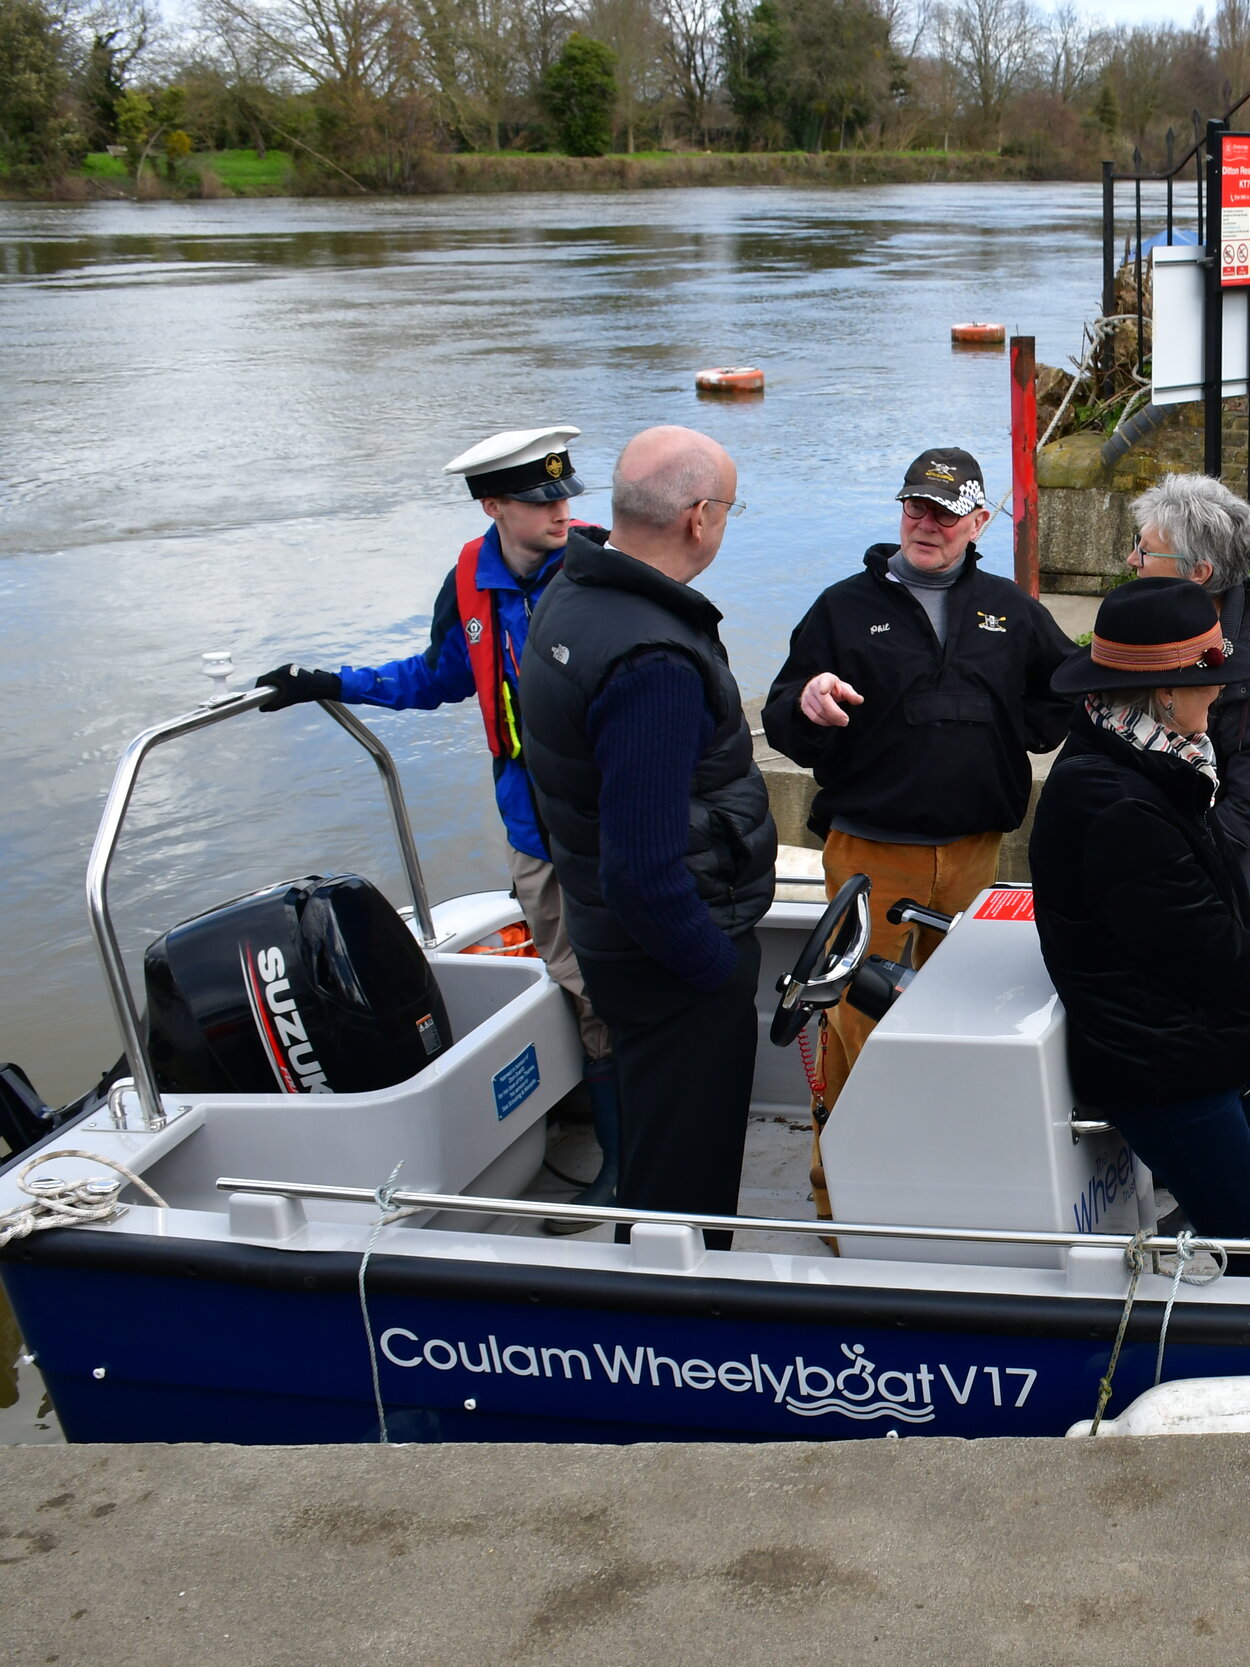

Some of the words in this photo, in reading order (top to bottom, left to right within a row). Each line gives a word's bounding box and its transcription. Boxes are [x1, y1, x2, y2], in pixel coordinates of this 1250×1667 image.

[1222, 166, 1239, 175] Ditton
[257, 946, 335, 1094] SUZUK
[1074, 1145, 1135, 1233] Wheel
[379, 1327, 592, 1381] Coulam
[938, 1363, 1038, 1408] V17
